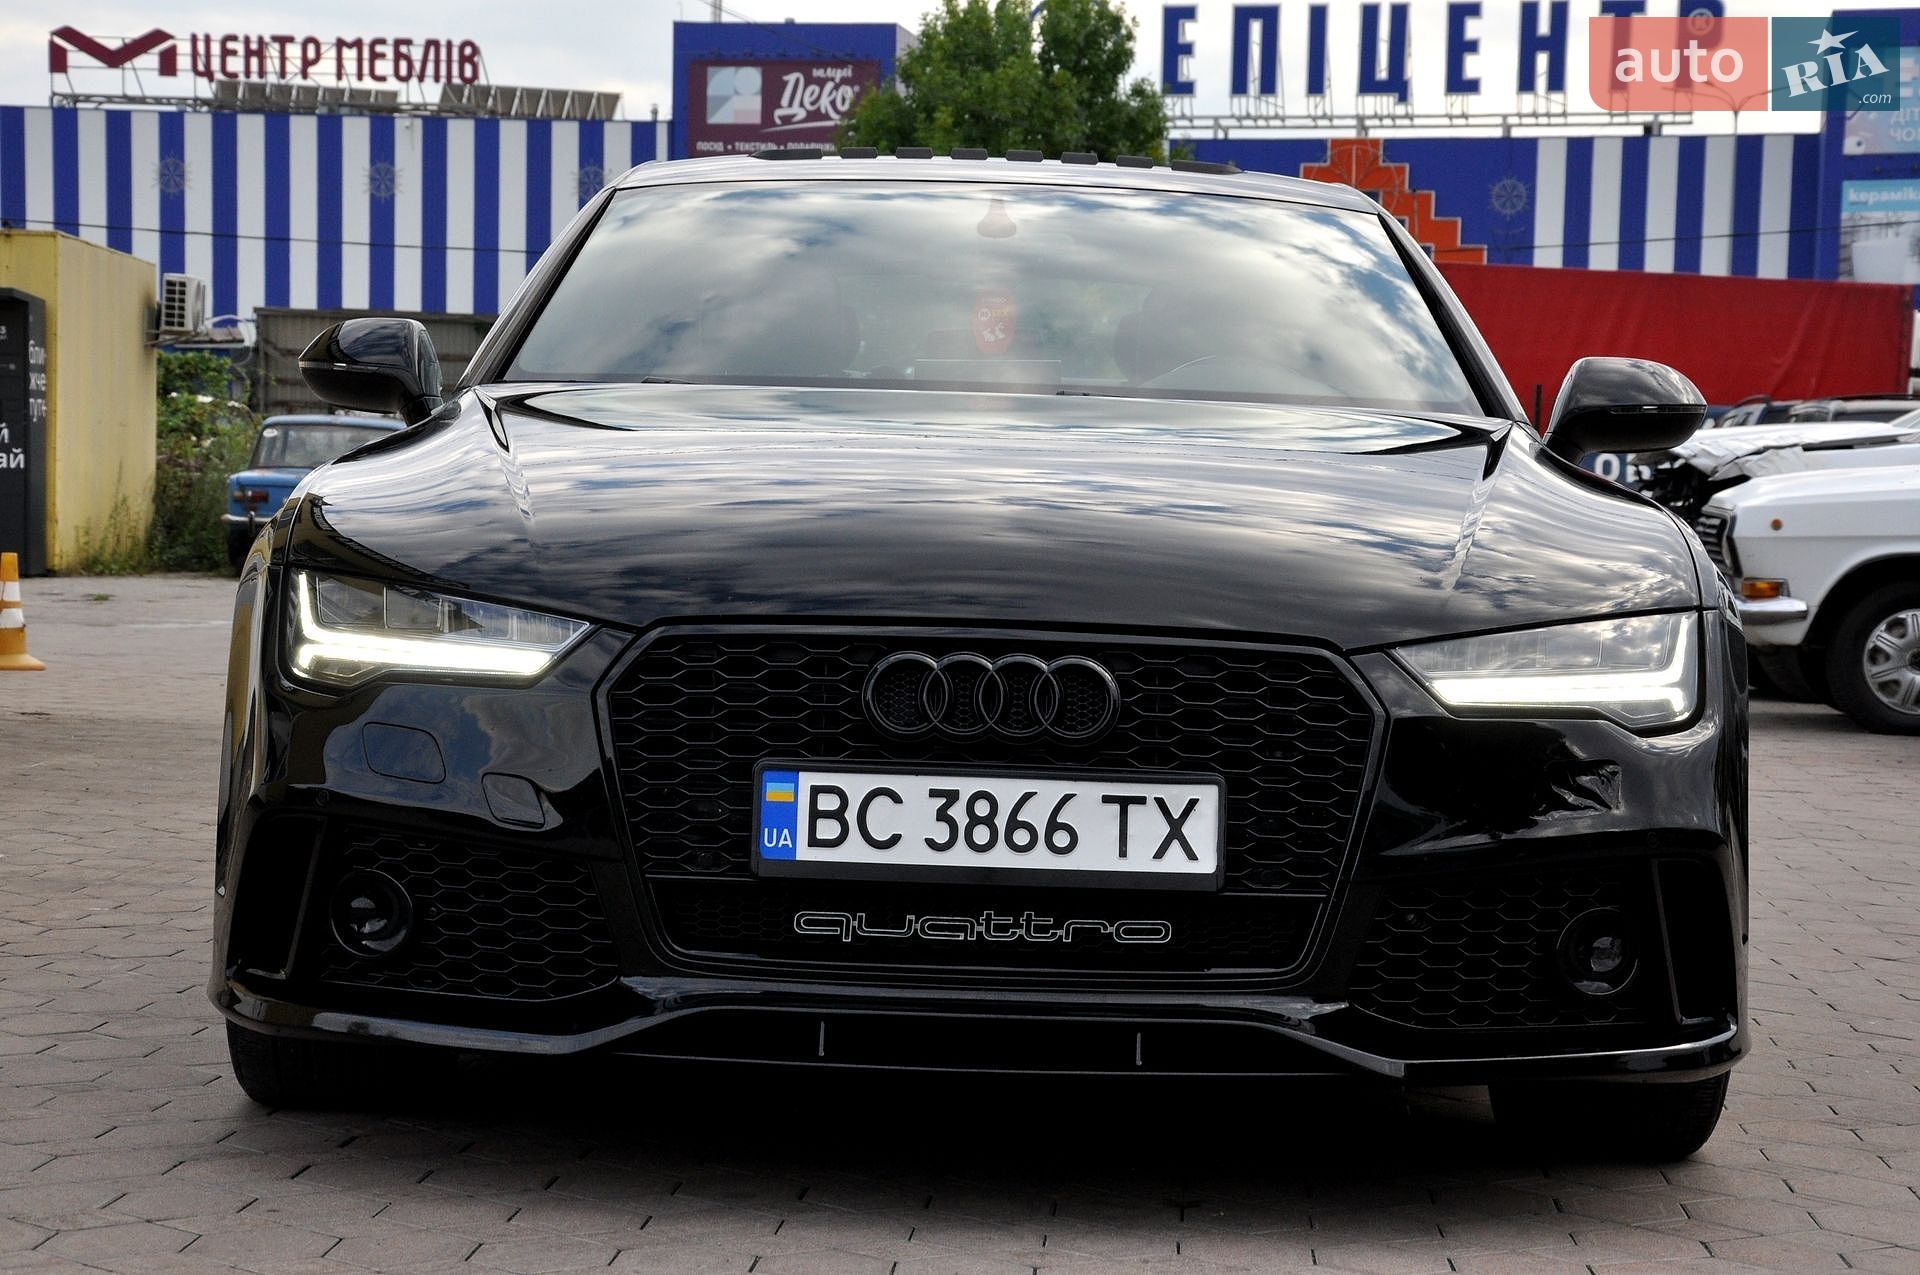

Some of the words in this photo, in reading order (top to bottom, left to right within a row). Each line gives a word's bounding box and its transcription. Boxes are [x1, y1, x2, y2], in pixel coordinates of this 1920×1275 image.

[190, 33, 321, 82] ЦЕНТР
[336, 36, 480, 84] МЕБЛІВ
[763, 828, 793, 848] UA
[808, 785, 904, 850] BC
[924, 789, 1080, 855] 3866
[1101, 794, 1200, 861] TX
[794, 911, 1172, 943] quattro
